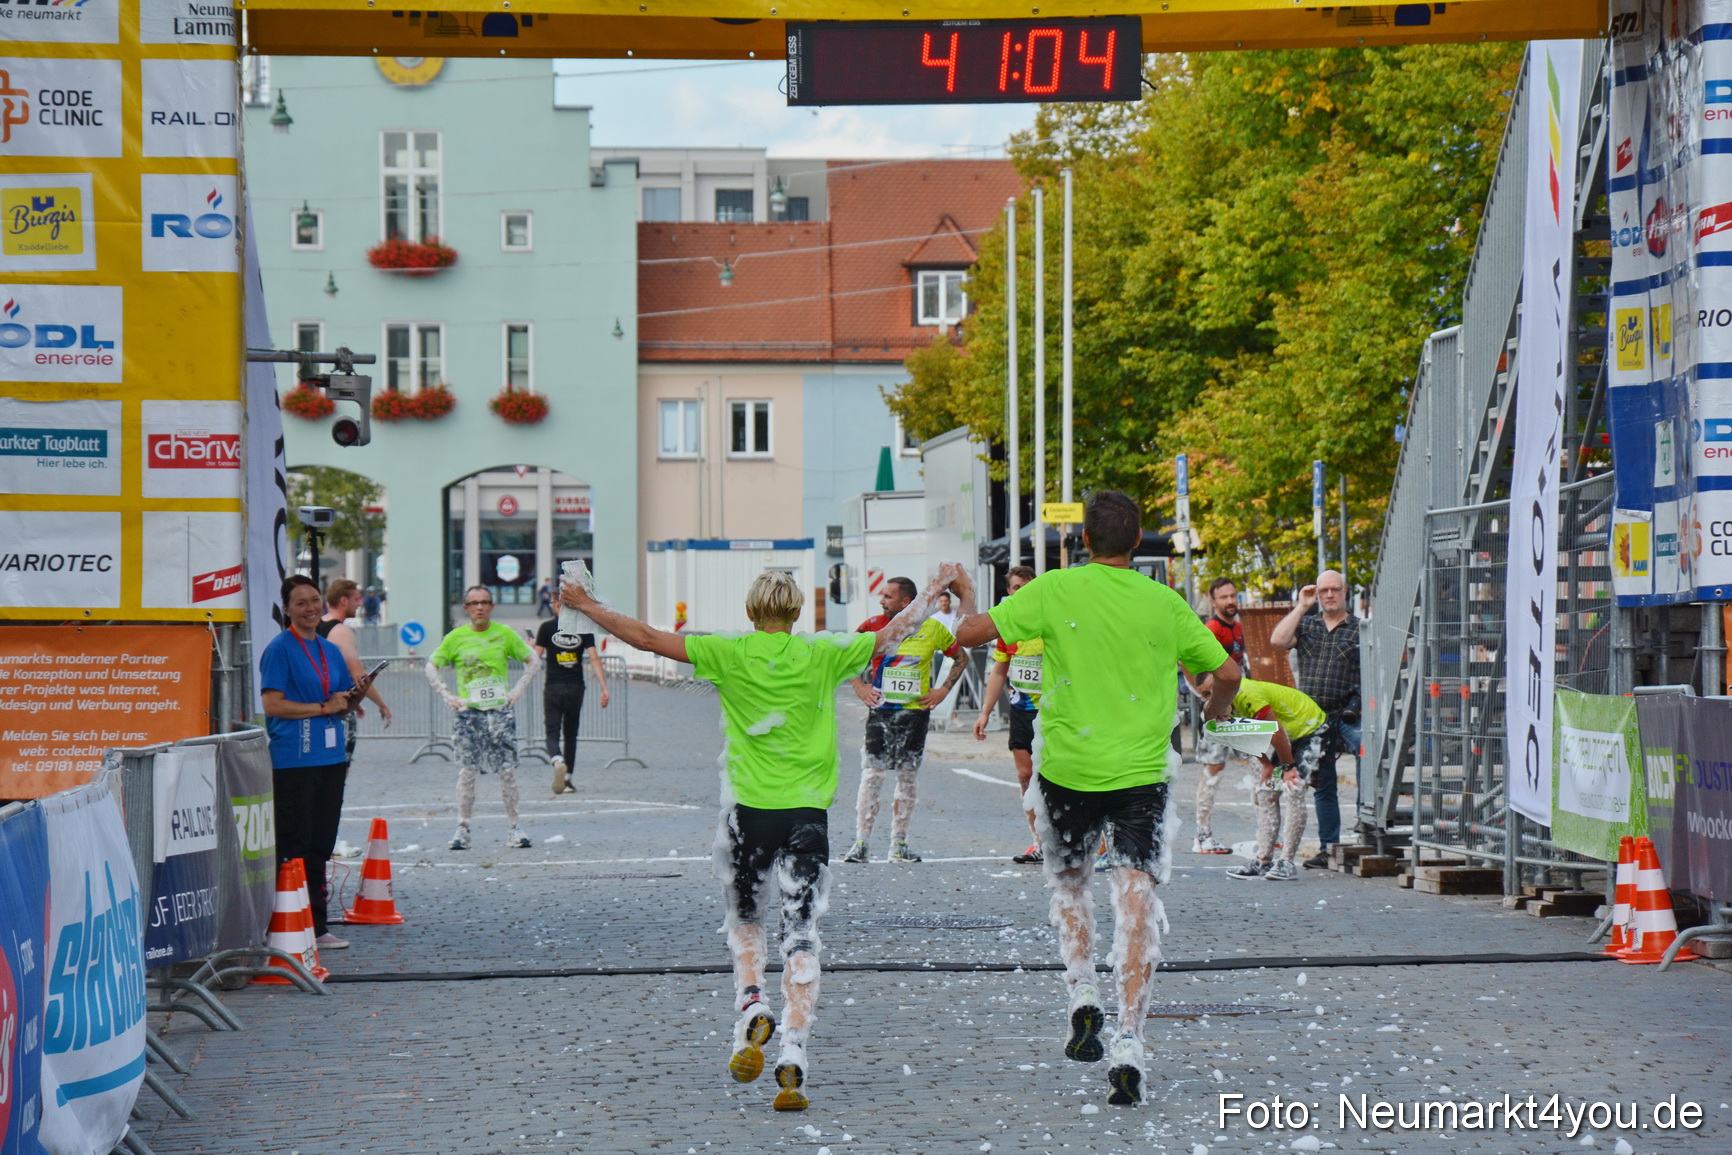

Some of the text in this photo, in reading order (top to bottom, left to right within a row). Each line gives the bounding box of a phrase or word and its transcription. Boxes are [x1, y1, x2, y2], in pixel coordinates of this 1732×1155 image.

[17, 9, 82, 21] neumarkt
[39, 90, 93, 107] CODE
[39, 109, 103, 126] CLINIC
[9, 204, 75, 241] Burgis
[42, 434, 101, 453] Tagblatt
[37, 457, 108, 469] Hier lebe ich.
[56, 653, 117, 664] moderner
[121, 654, 168, 664] Partner
[13, 669, 82, 682] Konzeption
[85, 669, 109, 680] und
[112, 669, 181, 683] Umsetzung
[1018, 669, 1039, 681] 182
[23, 684, 76, 698] Projekte
[80, 686, 105, 695] was
[108, 685, 160, 696] Internet,
[891, 680, 914, 691] 167
[480, 689, 495, 699] 85
[49, 699, 74, 710] und
[77, 699, 133, 713] Werbung
[135, 699, 180, 713] angeht.
[2, 730, 148, 741] Melden Sie sich bei uns:
[19, 745, 49, 756] web:
[12, 761, 32, 772] tel:
[36, 761, 73, 772] 09181
